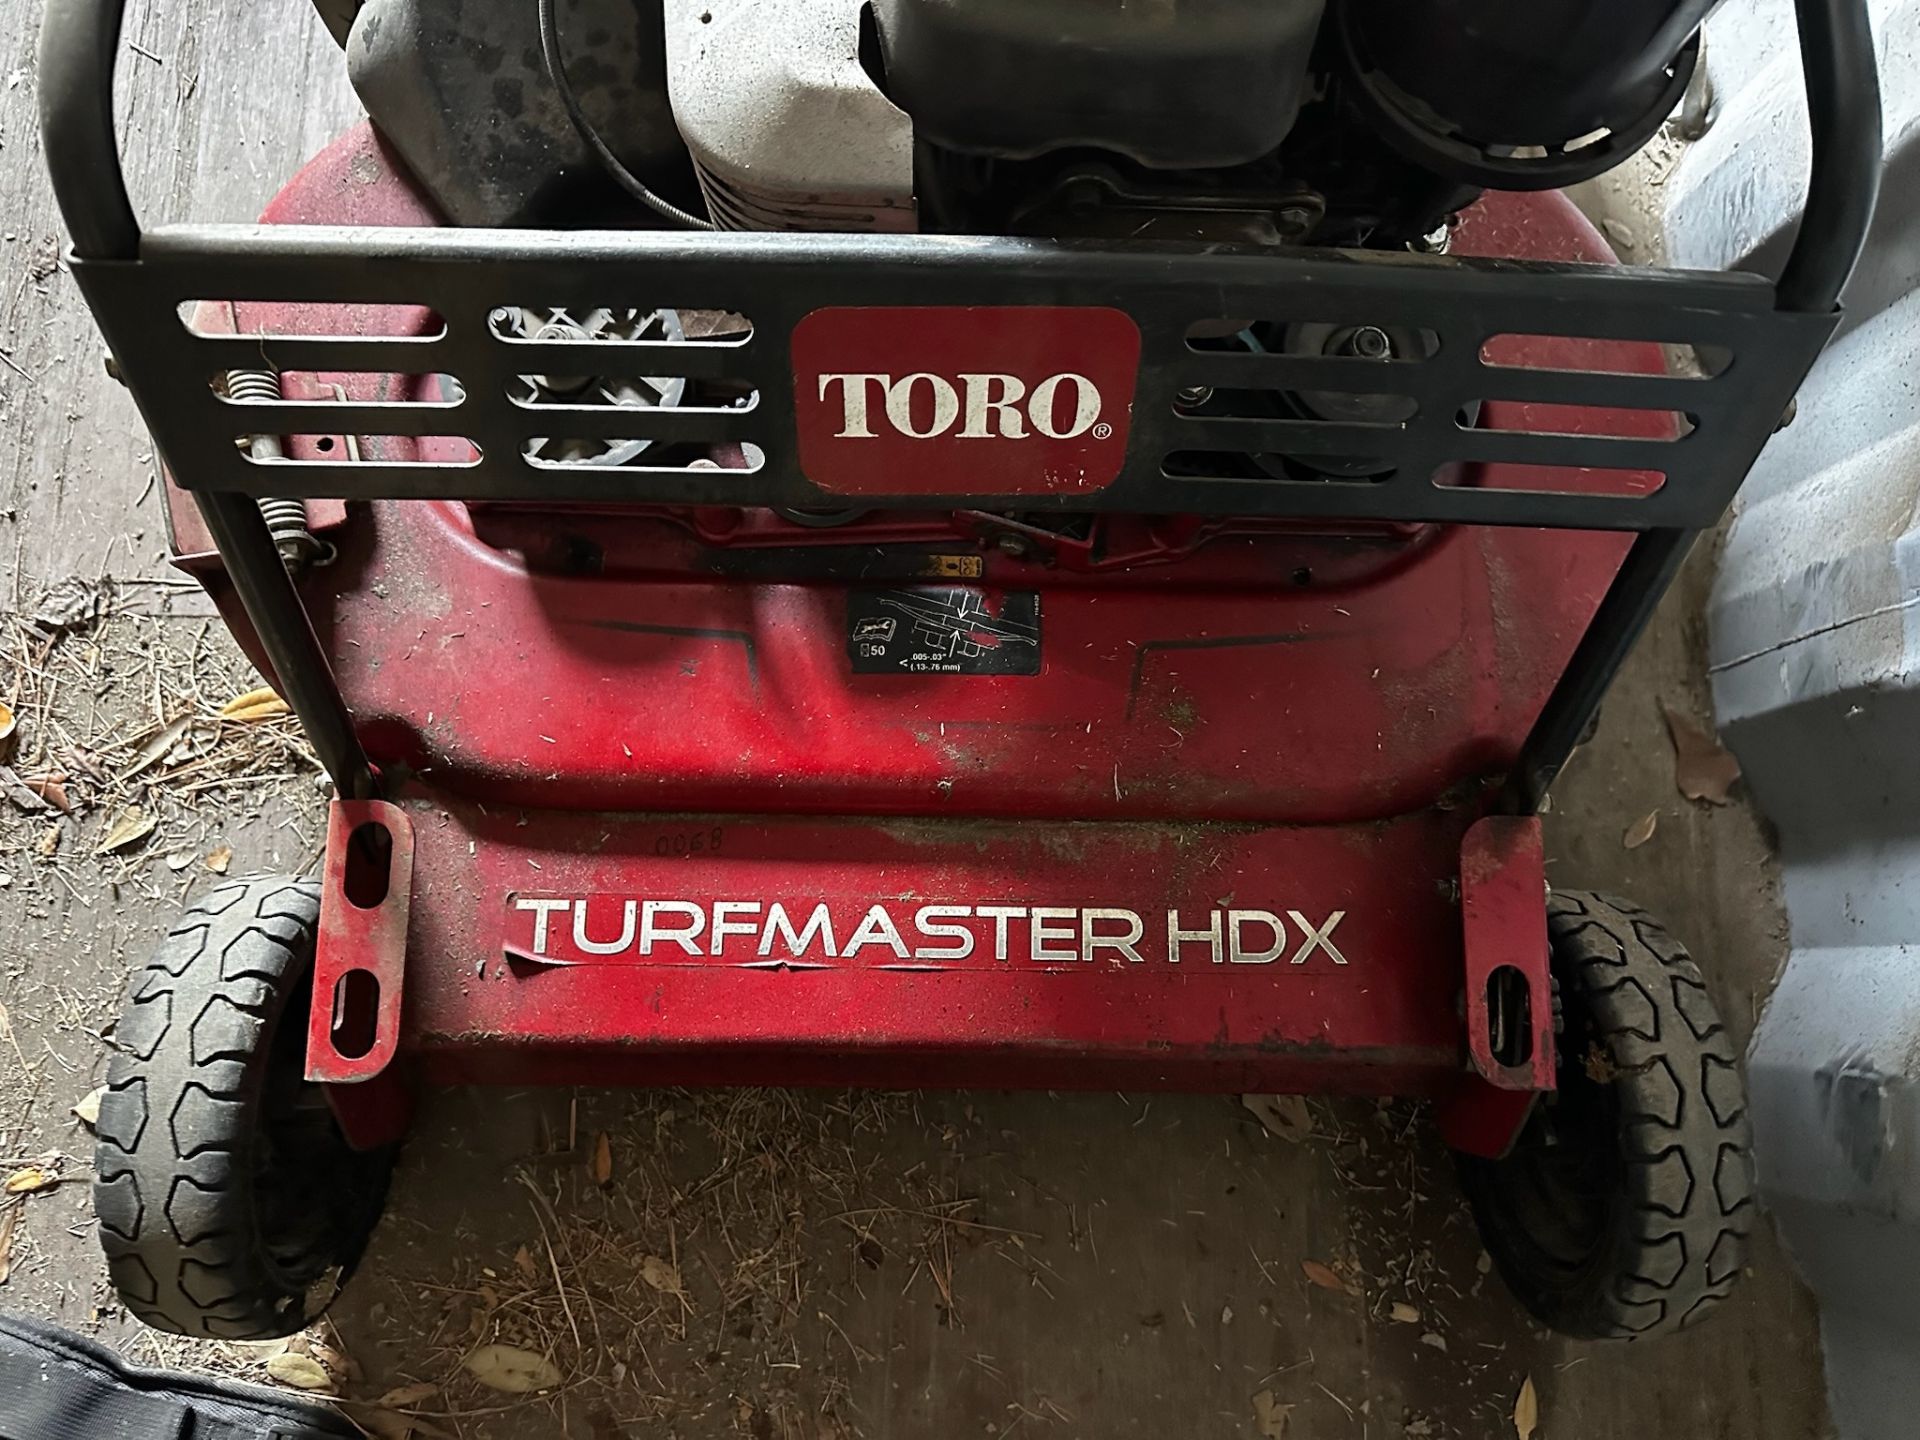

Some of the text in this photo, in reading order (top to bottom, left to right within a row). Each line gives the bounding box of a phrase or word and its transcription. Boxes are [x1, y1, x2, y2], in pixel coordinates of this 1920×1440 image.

[818, 372, 1102, 439] TORO
[870, 644, 886, 656] 50
[942, 663, 961, 672] mm)
[655, 826, 723, 857] 0068
[515, 899, 1349, 965] TURFMASTER HDX
